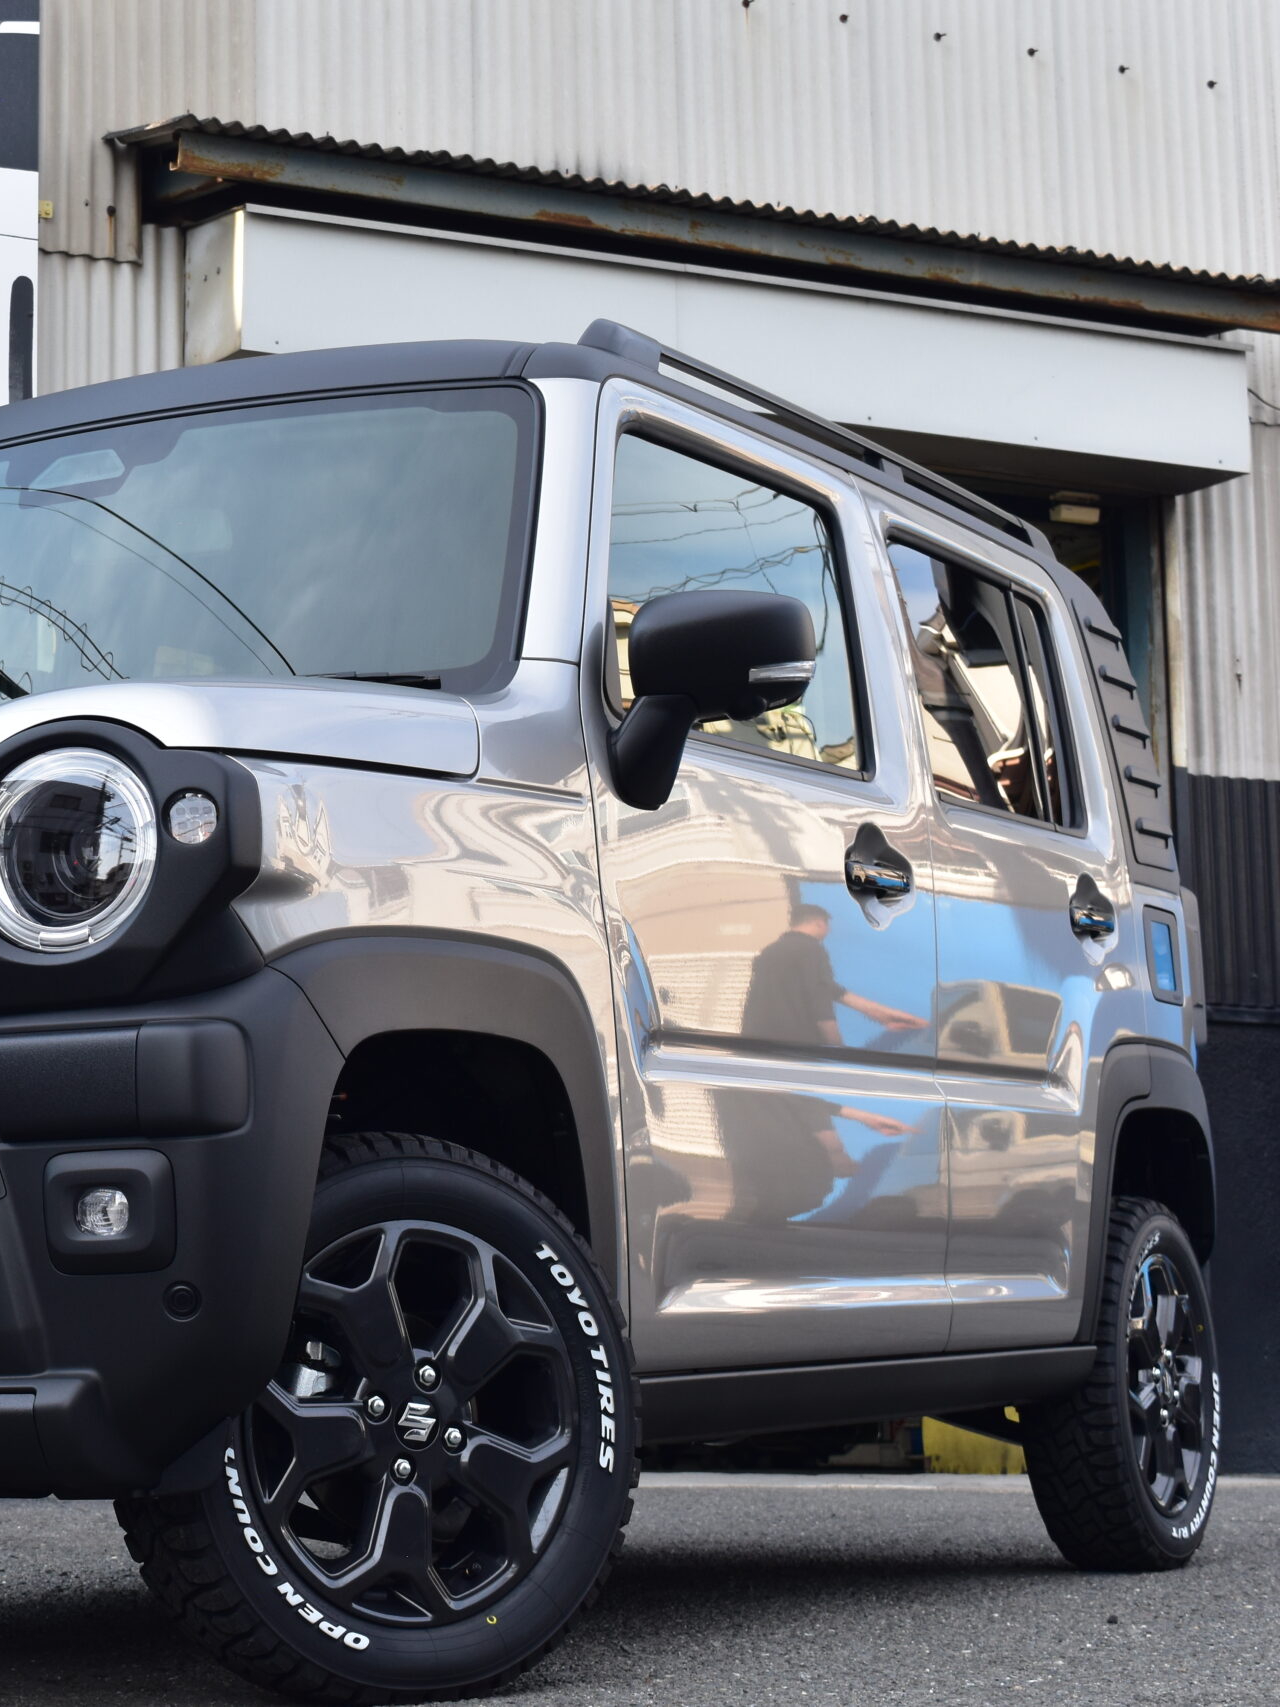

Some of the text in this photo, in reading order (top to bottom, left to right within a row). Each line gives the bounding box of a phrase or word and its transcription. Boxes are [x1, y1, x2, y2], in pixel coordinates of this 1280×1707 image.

[535, 1240, 616, 1474] TOYO TIRES
[1211, 1371, 1221, 1450] OPEN
[276, 1581, 370, 1650] OPEN
